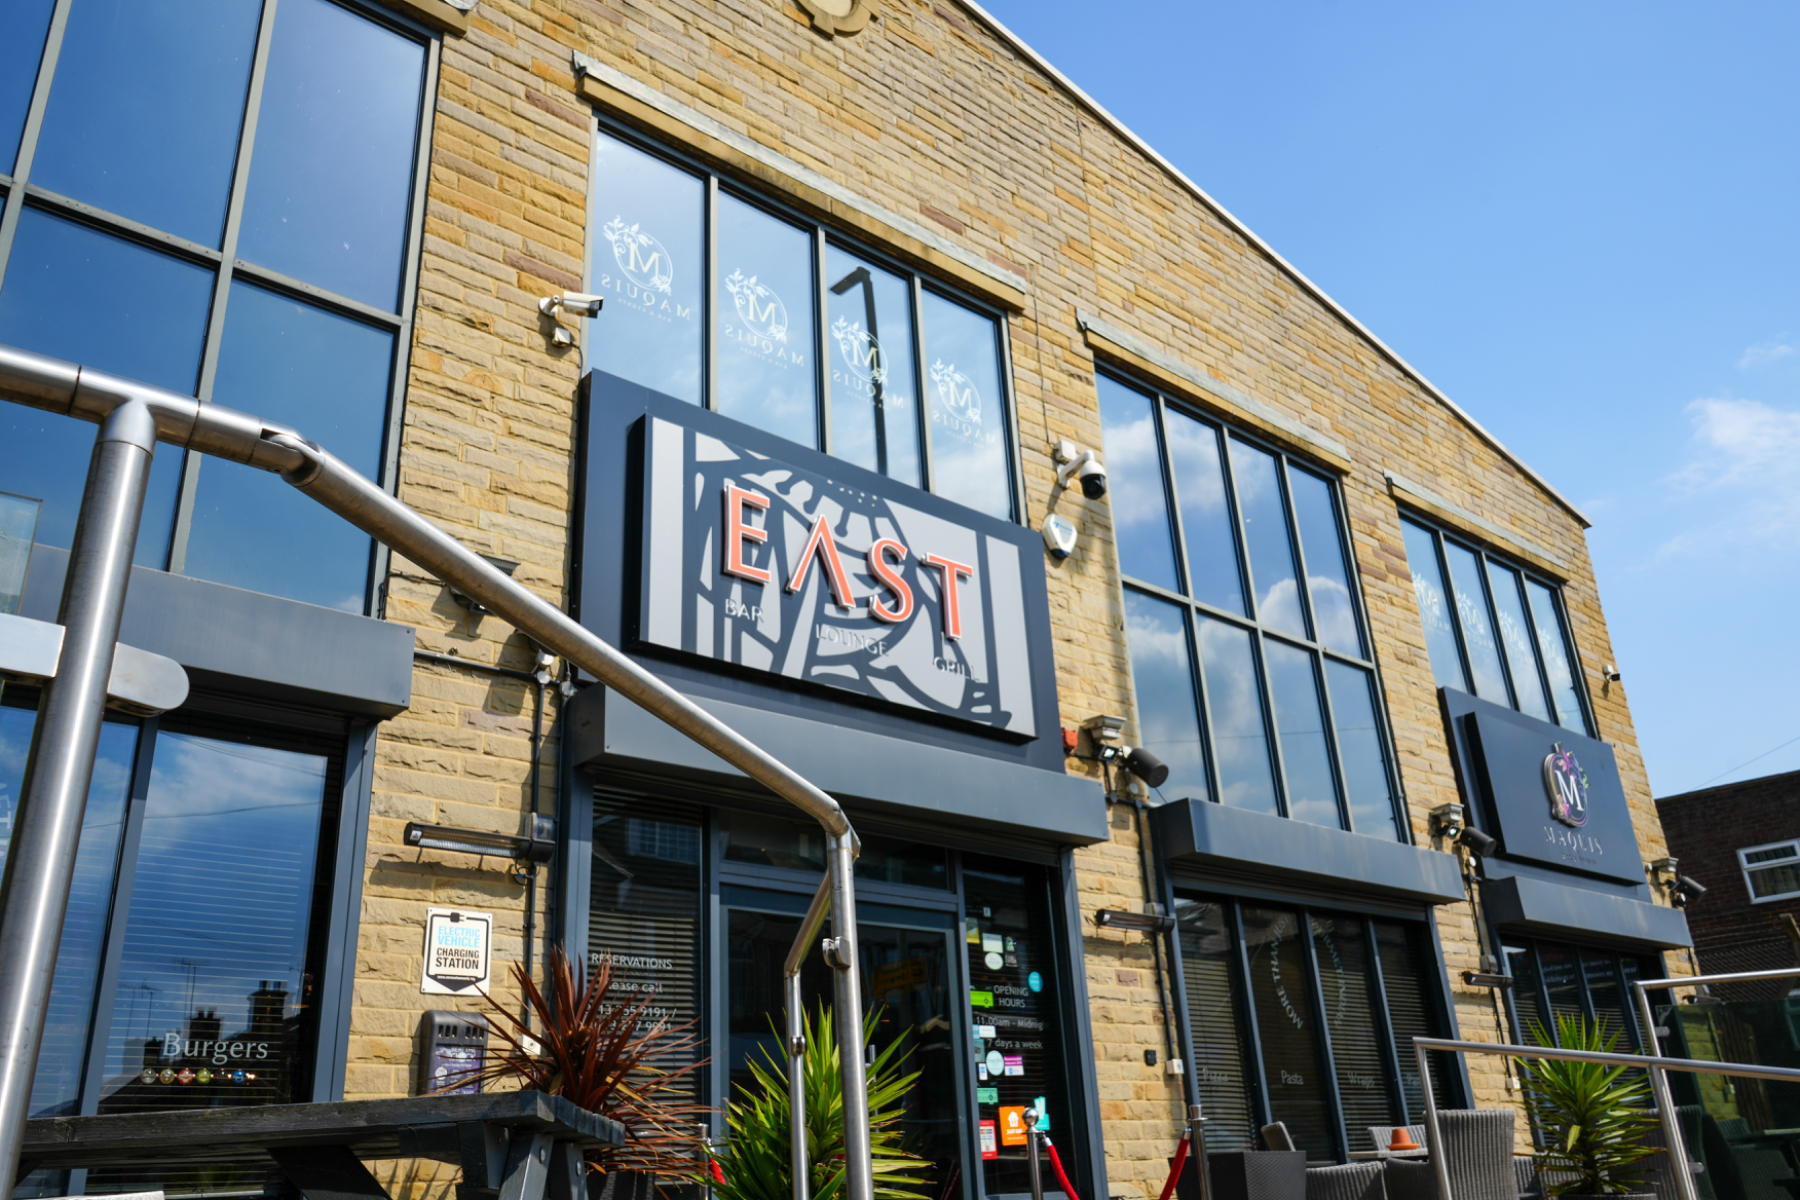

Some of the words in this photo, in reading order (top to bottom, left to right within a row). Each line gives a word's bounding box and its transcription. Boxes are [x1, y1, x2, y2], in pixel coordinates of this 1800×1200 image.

[724, 598, 764, 623] BAR
[815, 623, 890, 658] LOUNGE
[933, 655, 980, 682] GRILL
[1554, 769, 1584, 811] M
[1543, 825, 1603, 855] MAQUIS
[438, 925, 481, 938] ELECTRIC
[437, 935, 480, 949] VEHICLE
[436, 947, 480, 959] CHARGING
[435, 957, 479, 970] STATION
[591, 952, 673, 969] RESERVATIONS
[642, 982, 663, 993] call
[993, 985, 1029, 997] OPENING
[998, 998, 1026, 1008] HOURS
[1275, 985, 1304, 1030] MORE
[1017, 1019, 1044, 1031] Midnig
[163, 1032, 268, 1065] Burgers
[995, 1038, 1014, 1049] days
[1022, 1040, 1043, 1049] week
[1281, 1070, 1304, 1085] Pasta
